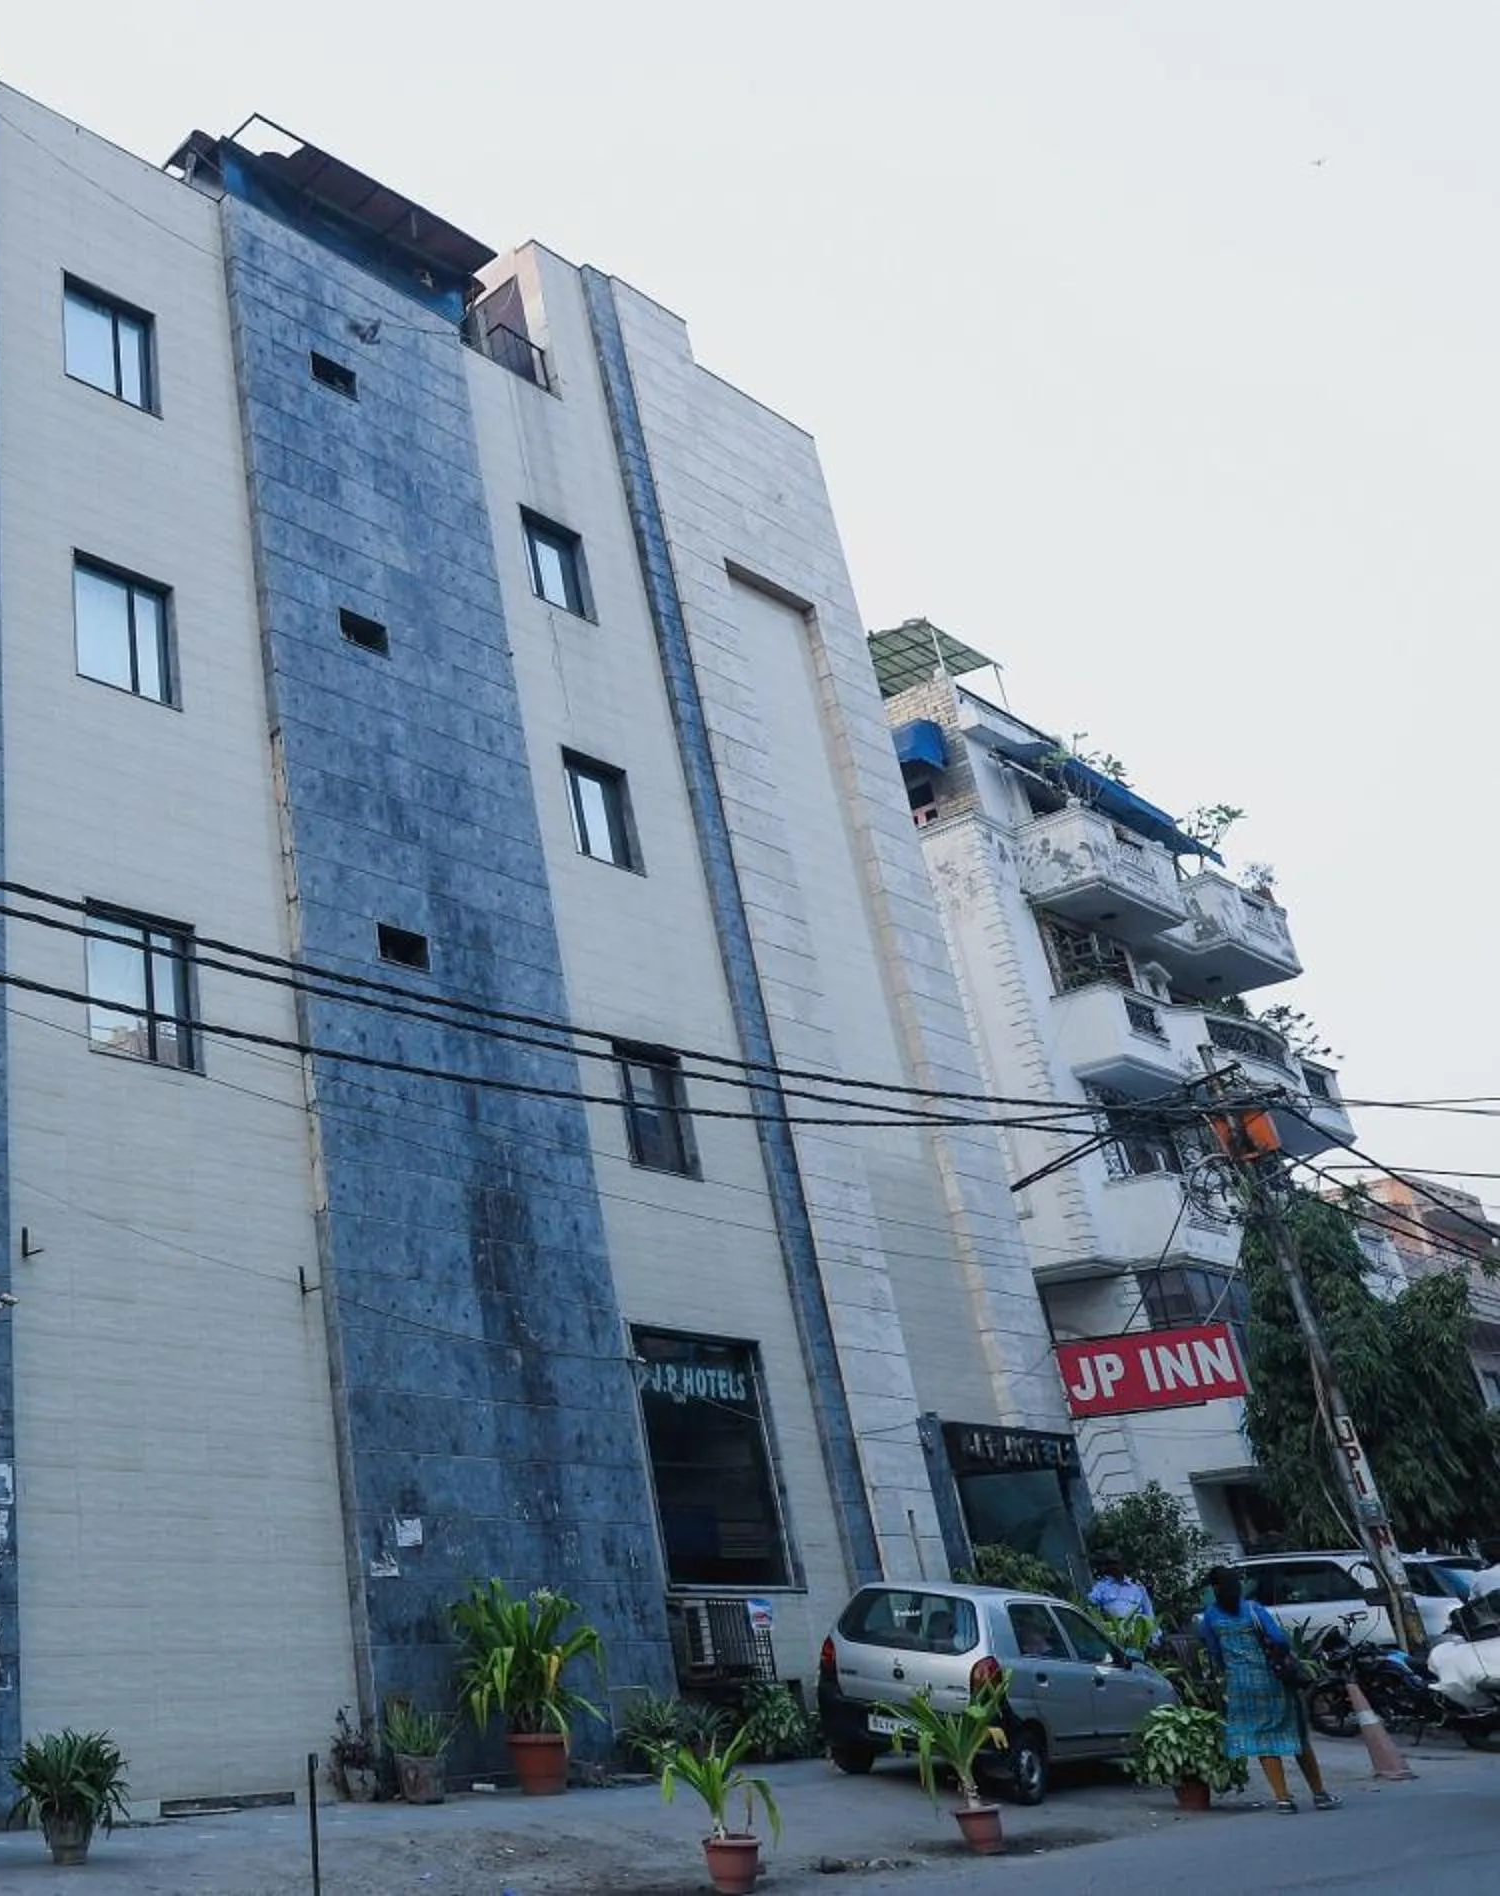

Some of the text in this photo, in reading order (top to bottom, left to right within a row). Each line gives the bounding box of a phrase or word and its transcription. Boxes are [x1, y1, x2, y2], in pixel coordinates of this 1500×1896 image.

[683, 1367, 747, 1400] HOTELS
[1070, 1337, 1237, 1401] JP INN
